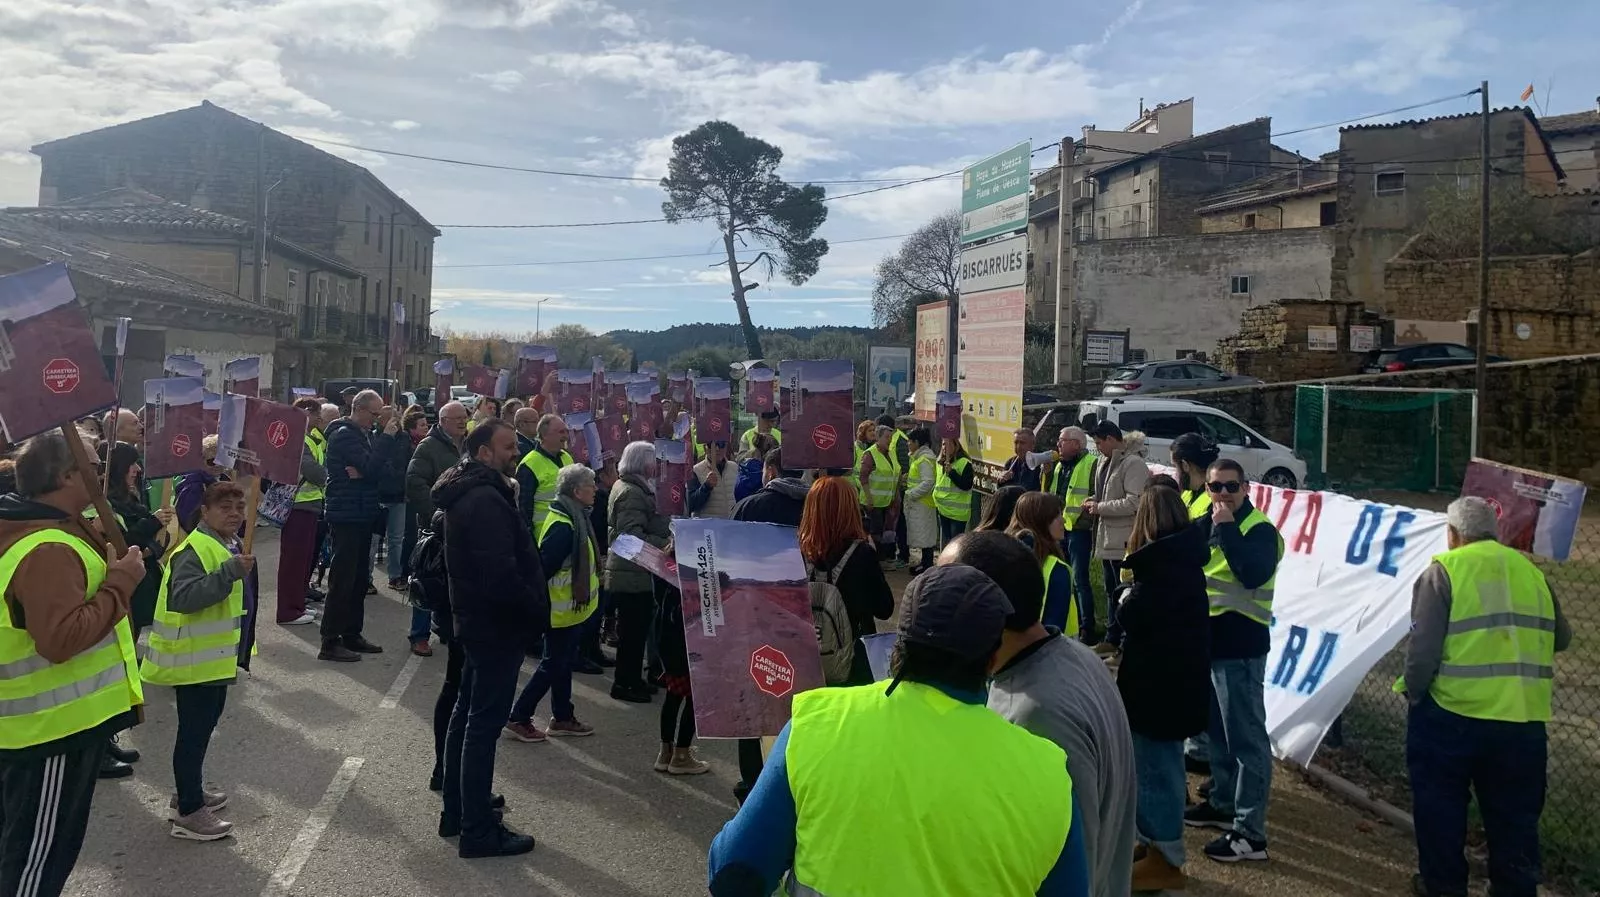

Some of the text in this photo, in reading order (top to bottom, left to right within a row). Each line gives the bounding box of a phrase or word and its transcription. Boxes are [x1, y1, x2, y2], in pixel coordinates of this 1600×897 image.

[962, 249, 1022, 280] BISCARRUÉS
[1345, 504, 1416, 577] DE
[755, 655, 791, 676] CARRETERA
